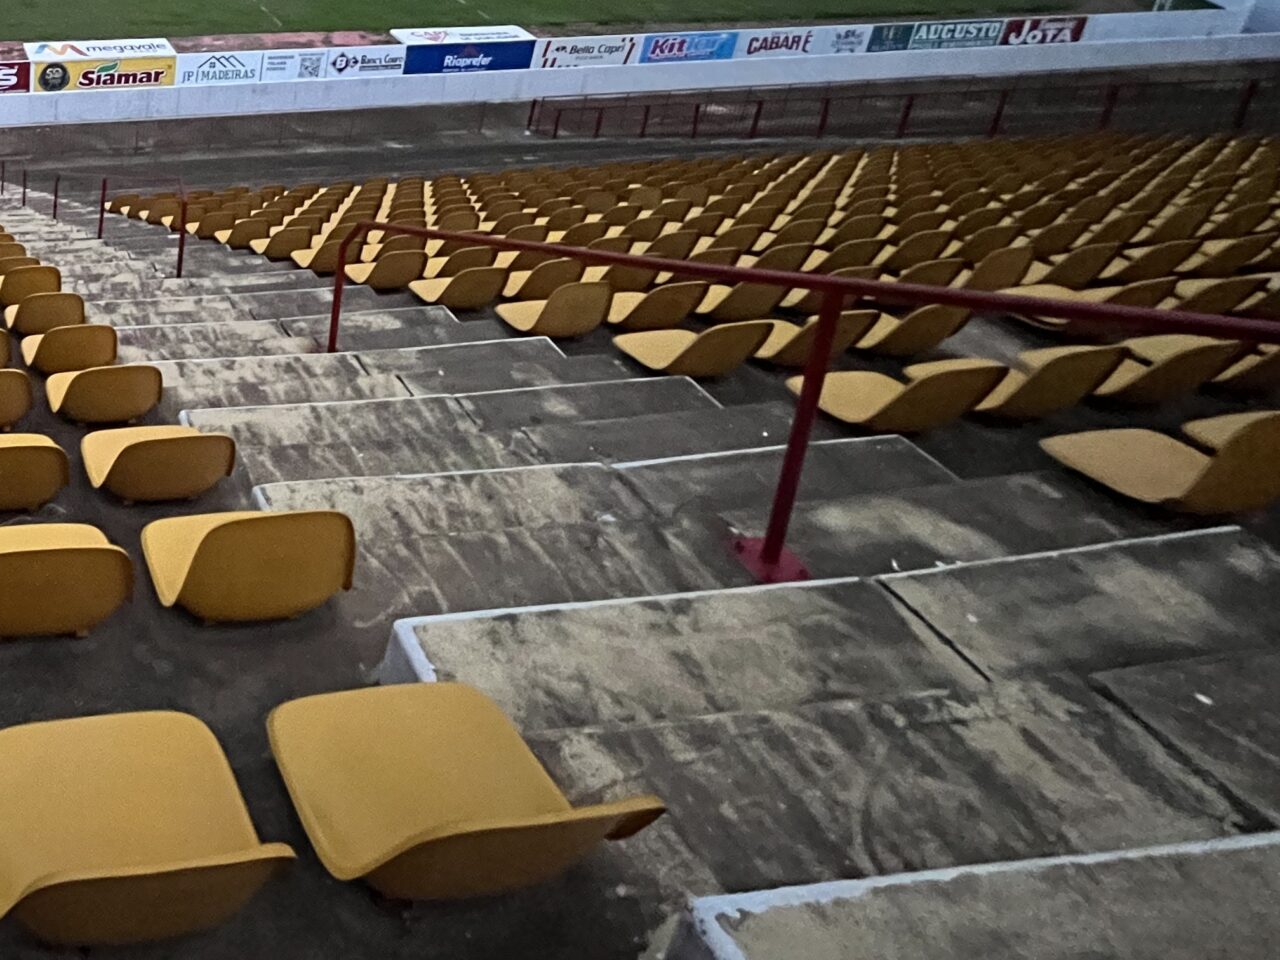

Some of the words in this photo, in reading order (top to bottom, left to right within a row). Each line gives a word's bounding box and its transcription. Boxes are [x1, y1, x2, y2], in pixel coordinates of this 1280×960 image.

[915, 23, 1000, 39] AUGUSTO
[86, 43, 167, 53] megavale
[598, 43, 625, 55] Capri
[747, 31, 813, 54] CABARÉ
[78, 69, 165, 87] Siamar
[201, 69, 255, 81] MADEIRAS
